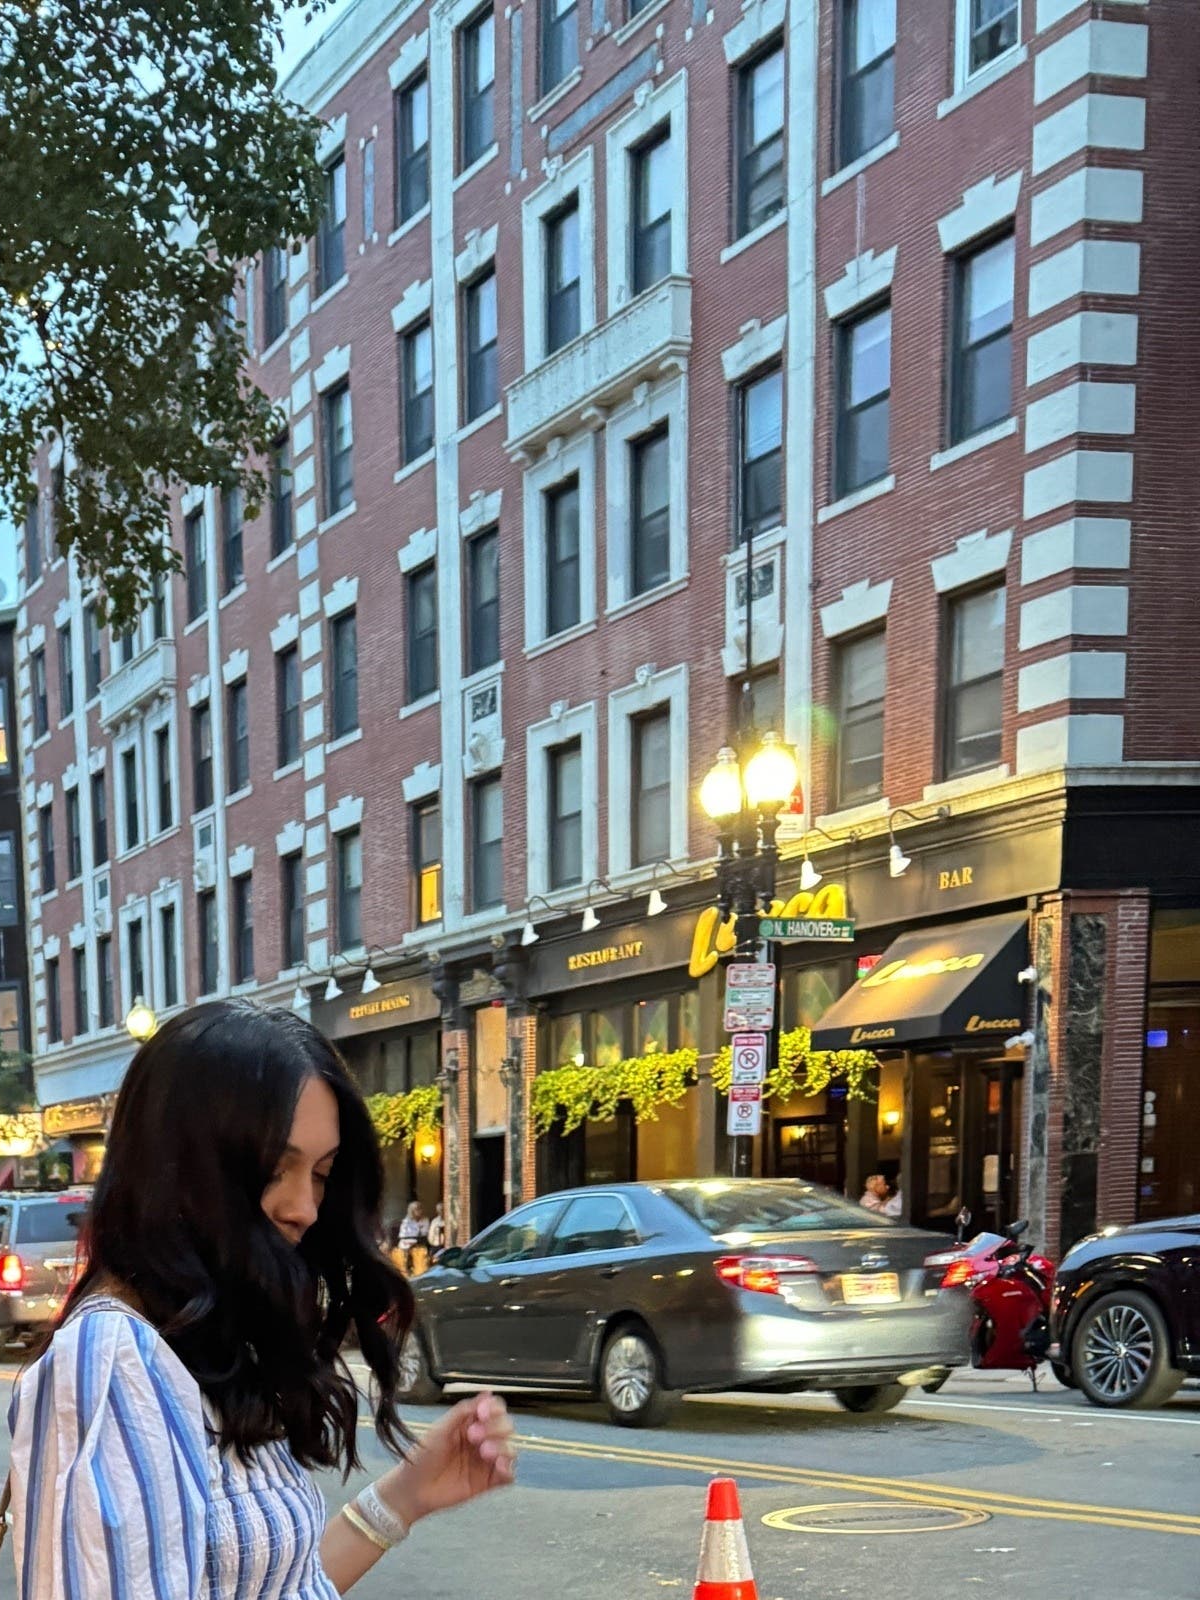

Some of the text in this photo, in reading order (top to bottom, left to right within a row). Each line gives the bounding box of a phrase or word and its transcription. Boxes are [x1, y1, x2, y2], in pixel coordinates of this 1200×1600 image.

[939, 867, 973, 889] BAR
[787, 921, 833, 937] HANOVER
[568, 940, 643, 970] RESTAURANT
[965, 1015, 1021, 1032] Lucca
[851, 1028, 896, 1044] Lucca
